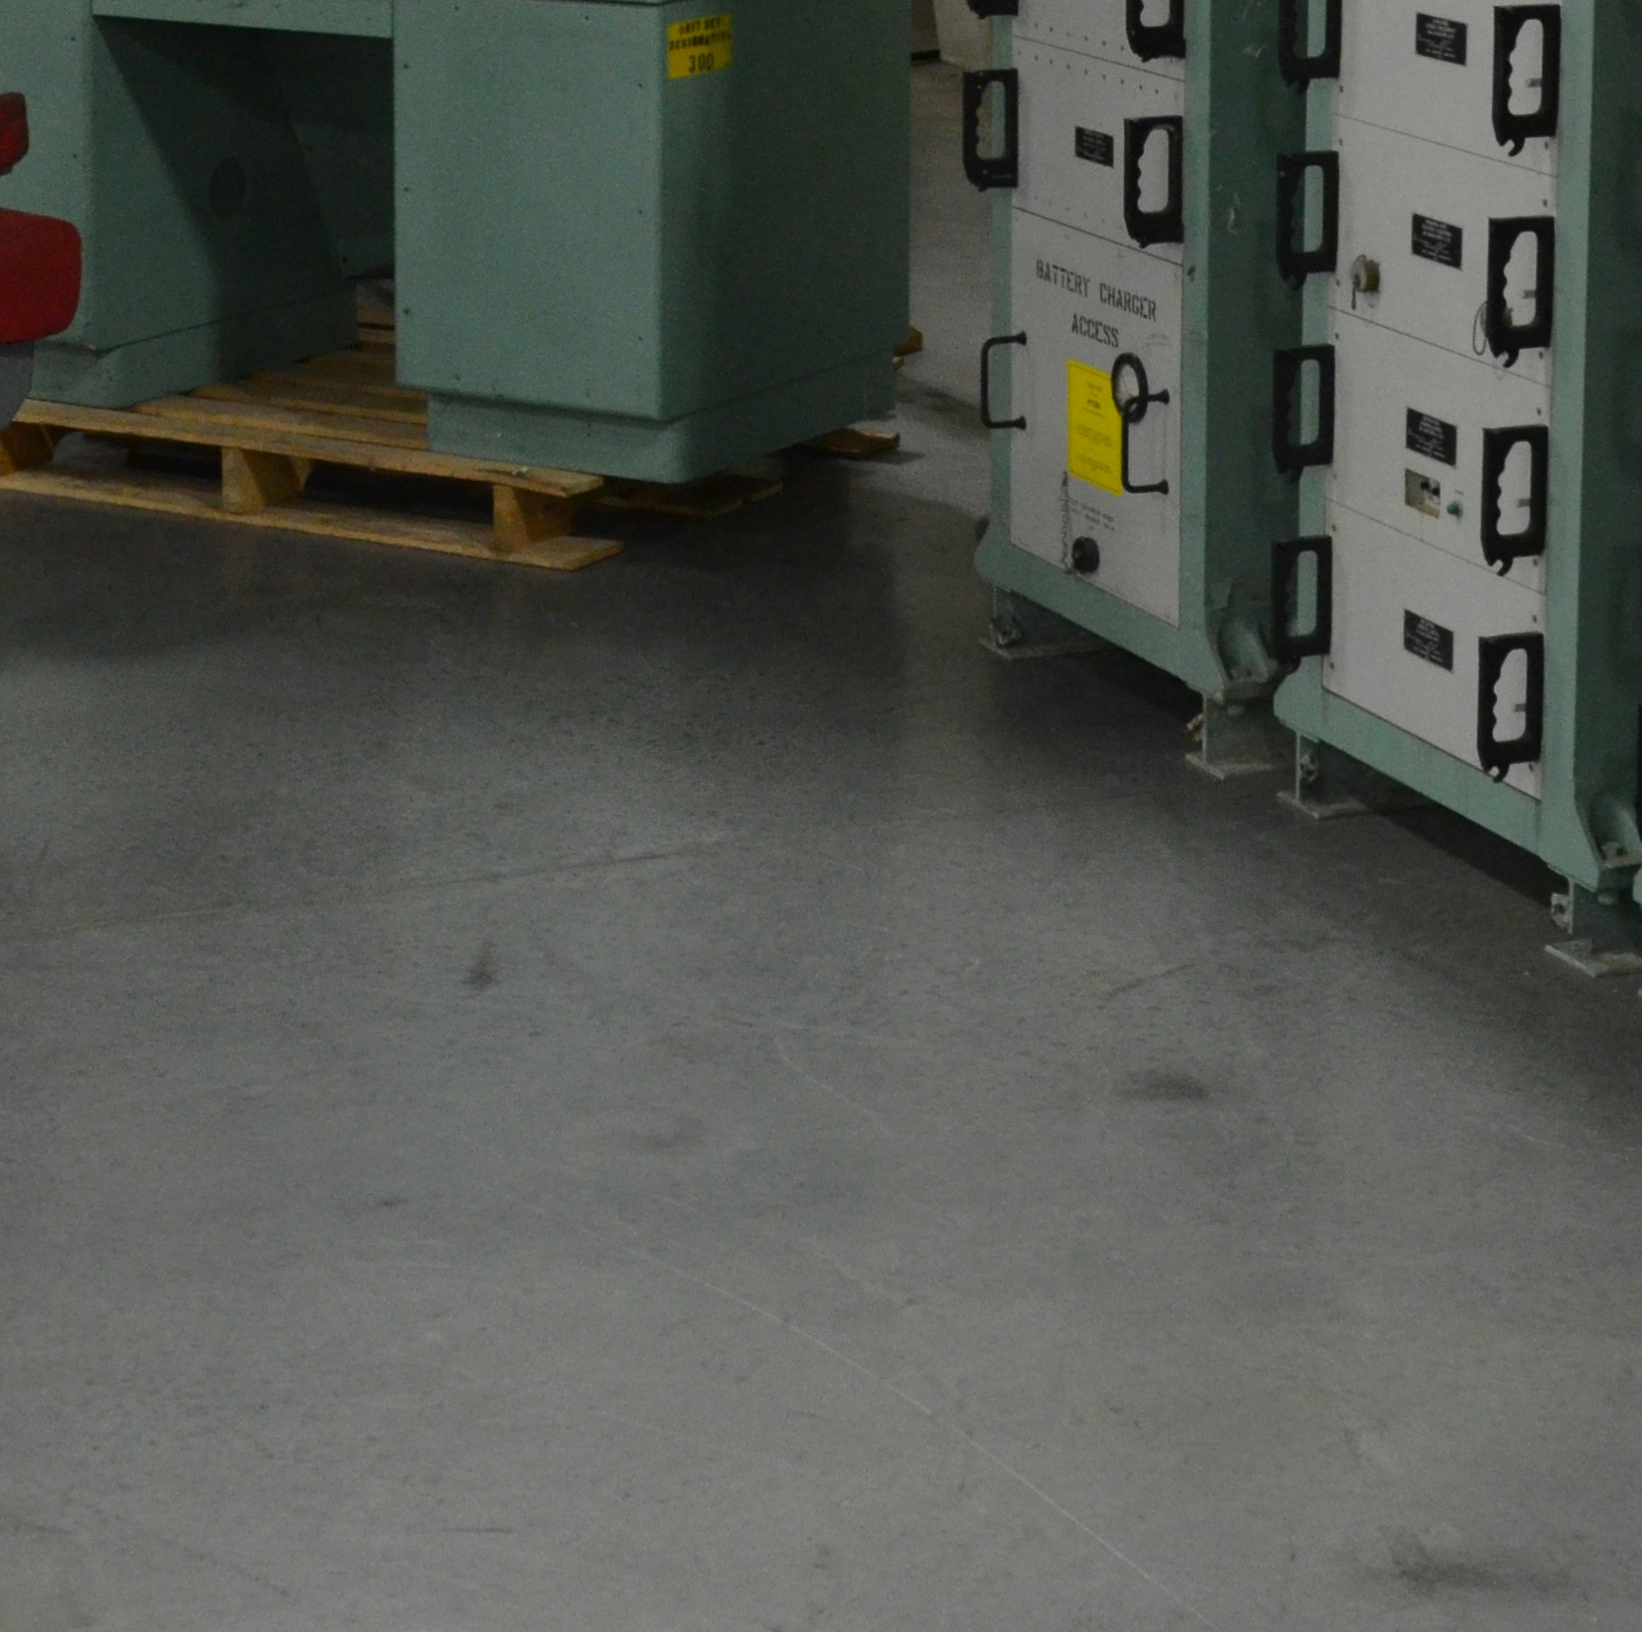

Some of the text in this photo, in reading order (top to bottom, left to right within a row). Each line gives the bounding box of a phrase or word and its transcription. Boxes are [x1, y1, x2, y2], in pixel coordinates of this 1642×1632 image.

[688, 52, 714, 74] 300
[1036, 258, 1156, 321] BATTERY CHARGER
[1072, 312, 1119, 348] ACCESS
